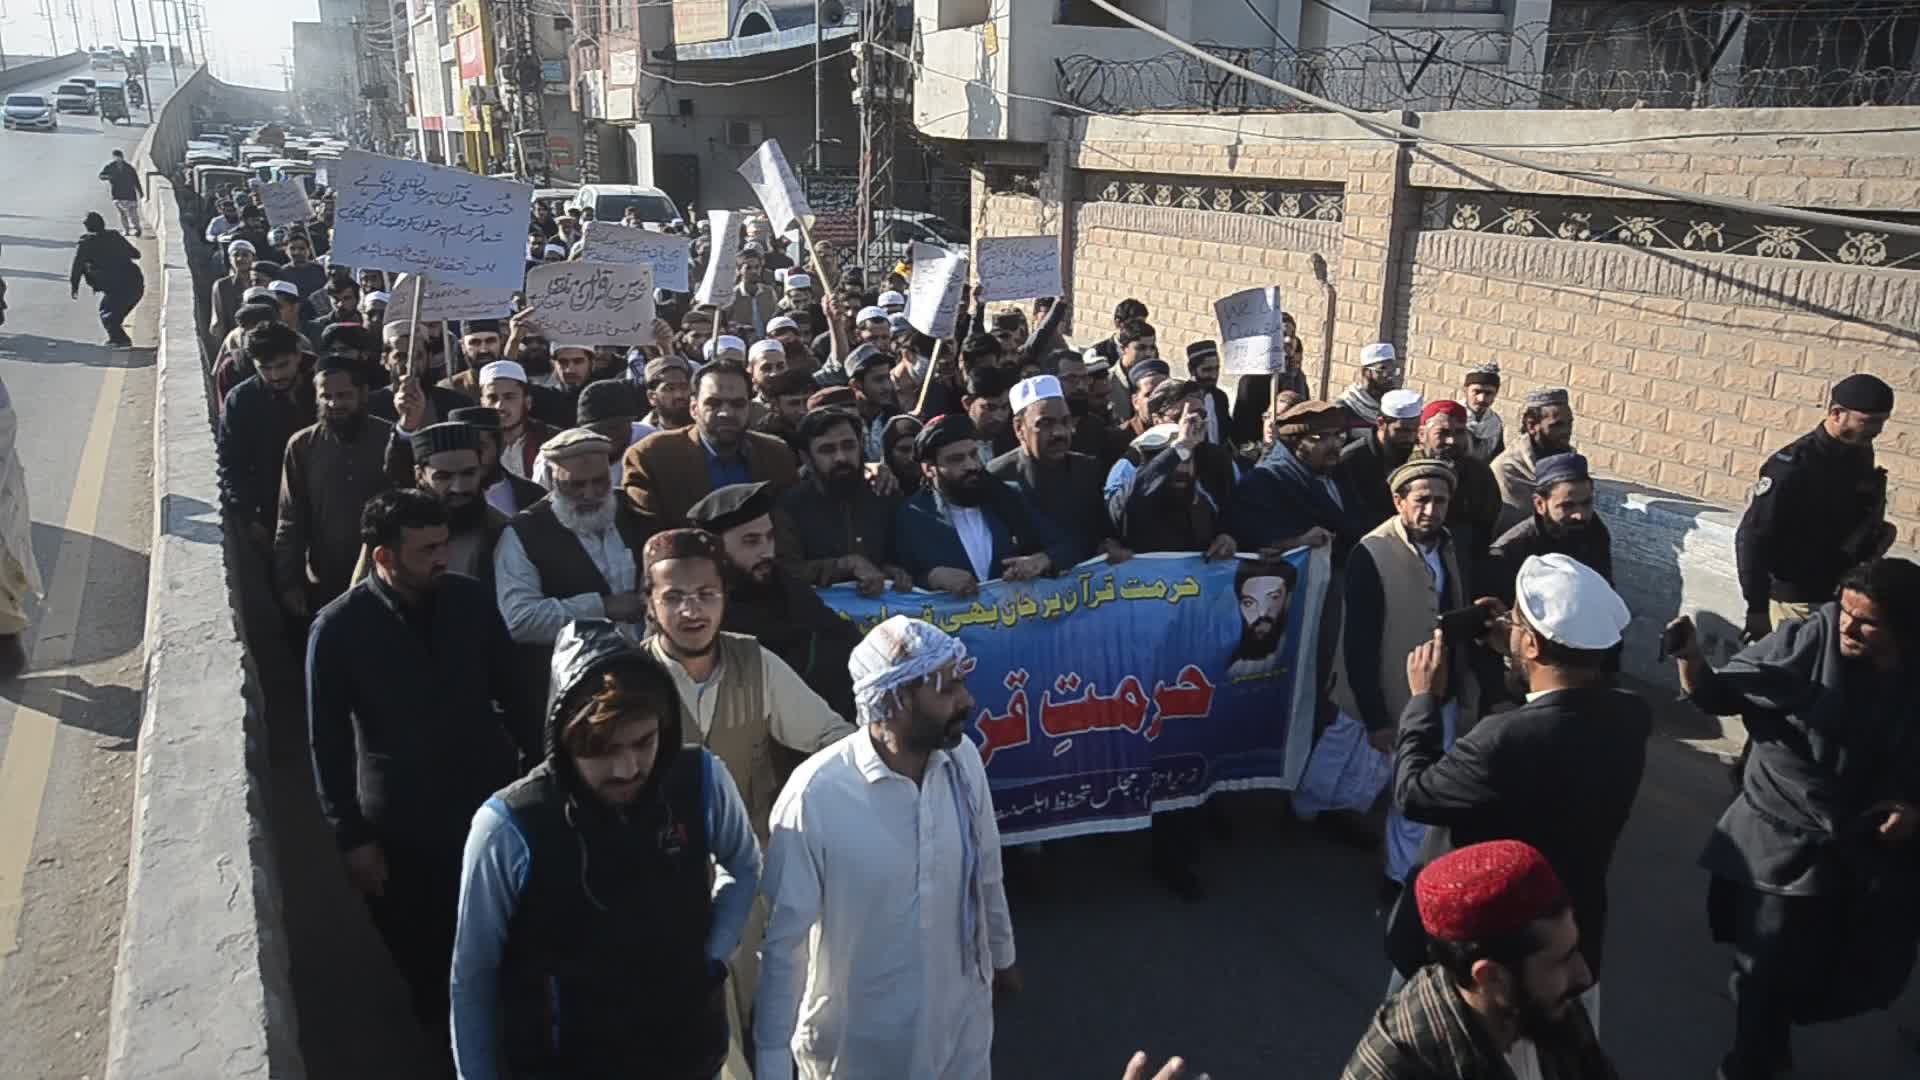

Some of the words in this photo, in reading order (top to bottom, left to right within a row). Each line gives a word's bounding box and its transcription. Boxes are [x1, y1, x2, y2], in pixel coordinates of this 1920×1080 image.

[1063, 572, 1116, 612] قرآن
[1119, 575, 1200, 604] حرمت
[938, 600, 1000, 633] بھی
[1000, 592, 1039, 627] جان
[973, 667, 1031, 768] قر
[1050, 784, 1092, 812] تحفظ
[1089, 772, 1139, 810] مجلس
